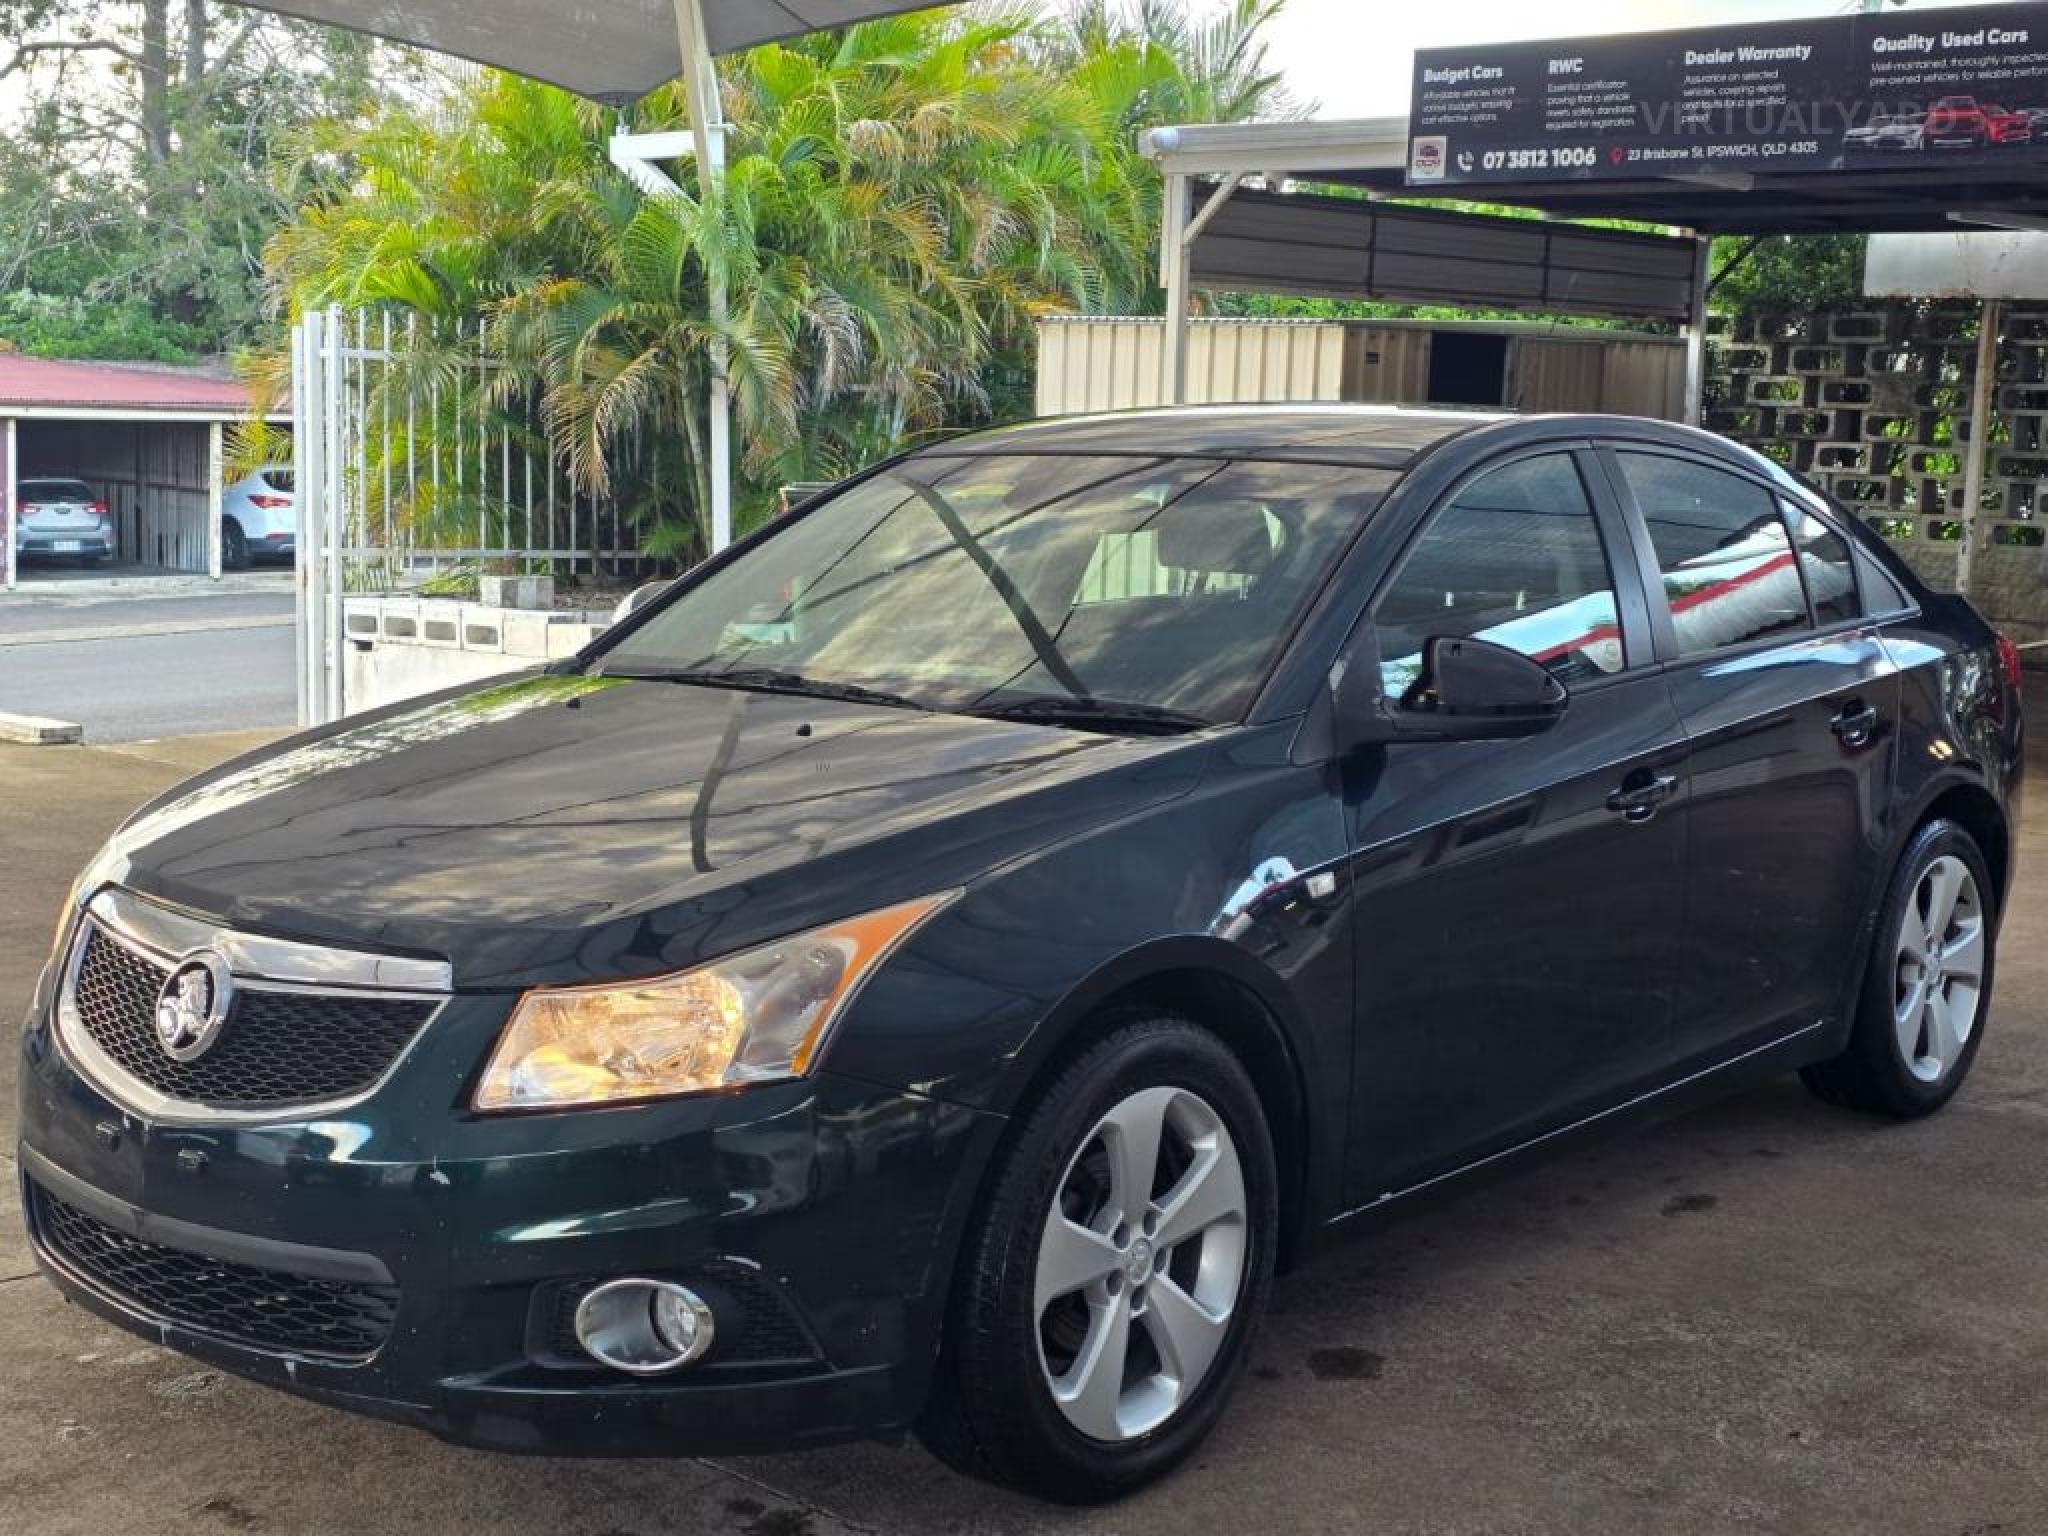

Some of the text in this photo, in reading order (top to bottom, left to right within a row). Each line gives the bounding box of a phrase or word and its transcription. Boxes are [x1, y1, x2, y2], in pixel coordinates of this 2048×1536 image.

[1872, 27, 2029, 52] Quality Used Cars
[1685, 44, 1813, 65] Dealer Warranty
[1423, 65, 1503, 85] Budget Cars
[1548, 58, 1584, 74] RWC
[1961, 69, 1975, 81] for
[1483, 146, 1598, 169] 07 3812 1006
[1627, 148, 1641, 160] 23
[1643, 147, 1689, 160] Brisbane
[1761, 143, 1787, 157] QLD
[1789, 141, 1818, 154] 4305
